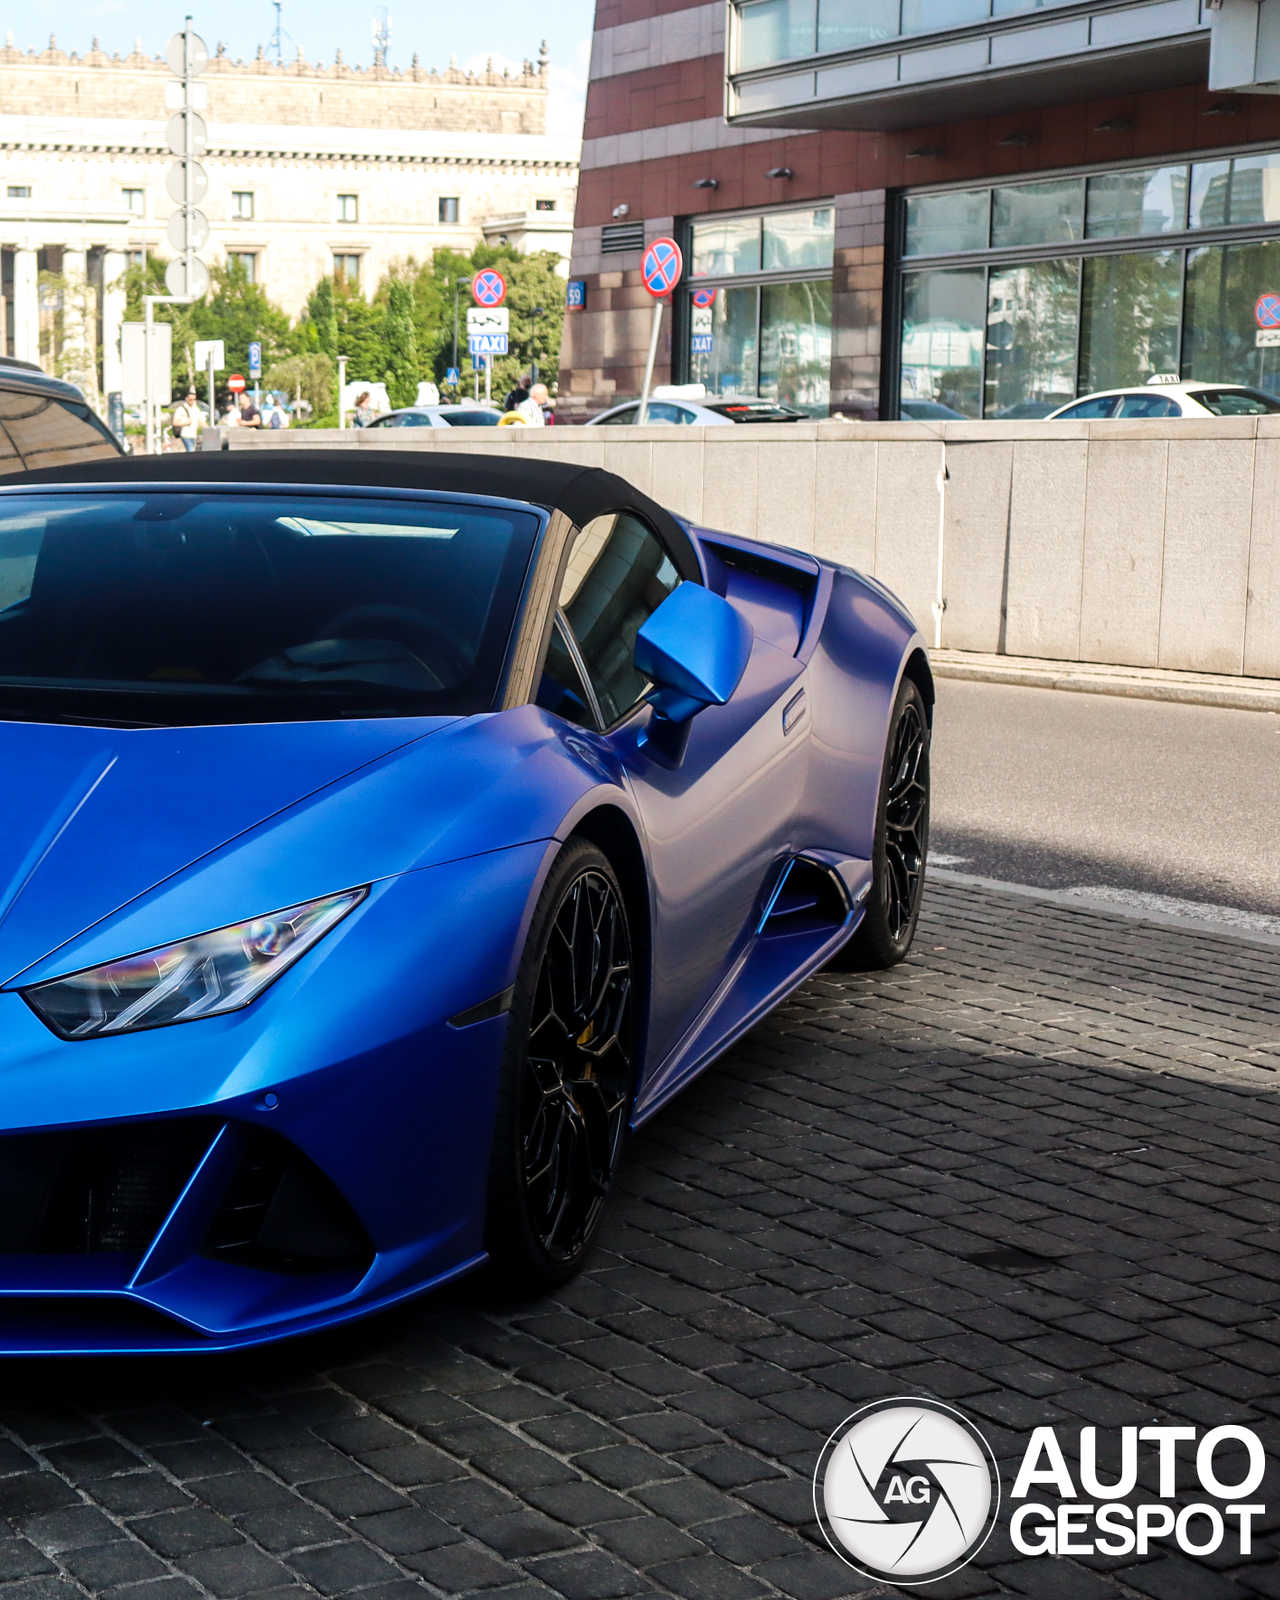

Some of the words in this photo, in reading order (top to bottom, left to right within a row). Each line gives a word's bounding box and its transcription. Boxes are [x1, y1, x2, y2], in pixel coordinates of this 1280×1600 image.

[568, 288, 581, 305] 59
[472, 336, 505, 351] TAXI
[1159, 375, 1179, 383] TAXI
